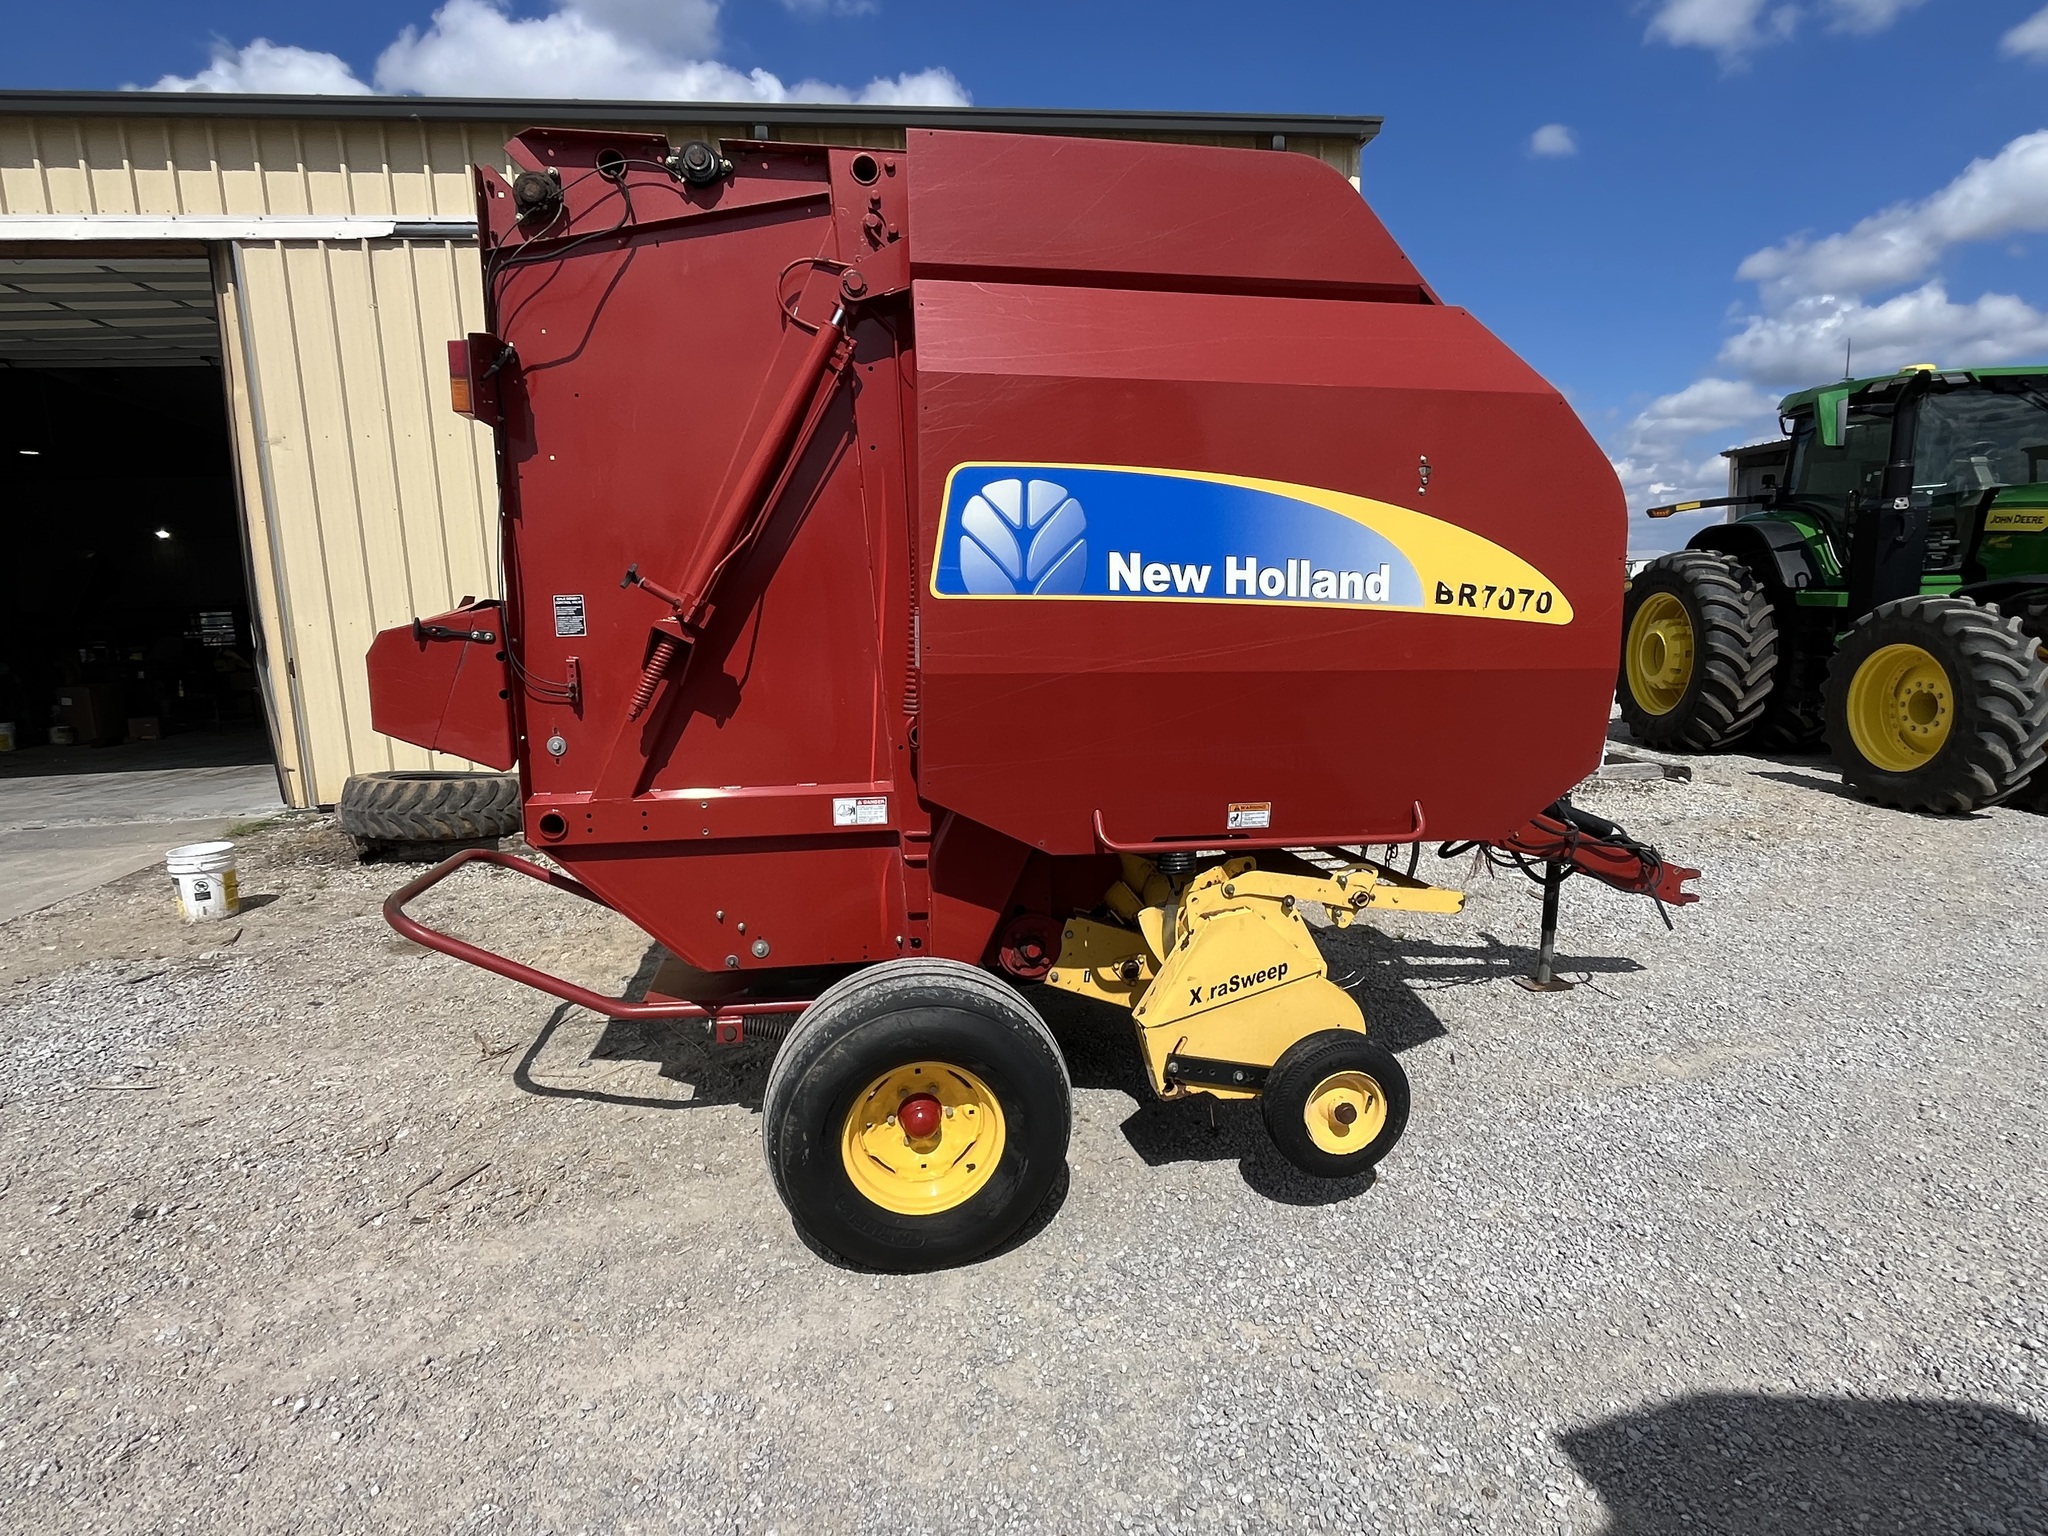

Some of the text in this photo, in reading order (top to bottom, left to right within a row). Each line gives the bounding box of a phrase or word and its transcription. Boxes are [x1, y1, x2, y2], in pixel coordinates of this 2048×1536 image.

[1990, 515, 2045, 524] JOHN DEERE
[1108, 551, 1390, 602] New Holland
[1435, 580, 1553, 614] BR7070
[1188, 962, 1288, 1007] XraSweep
